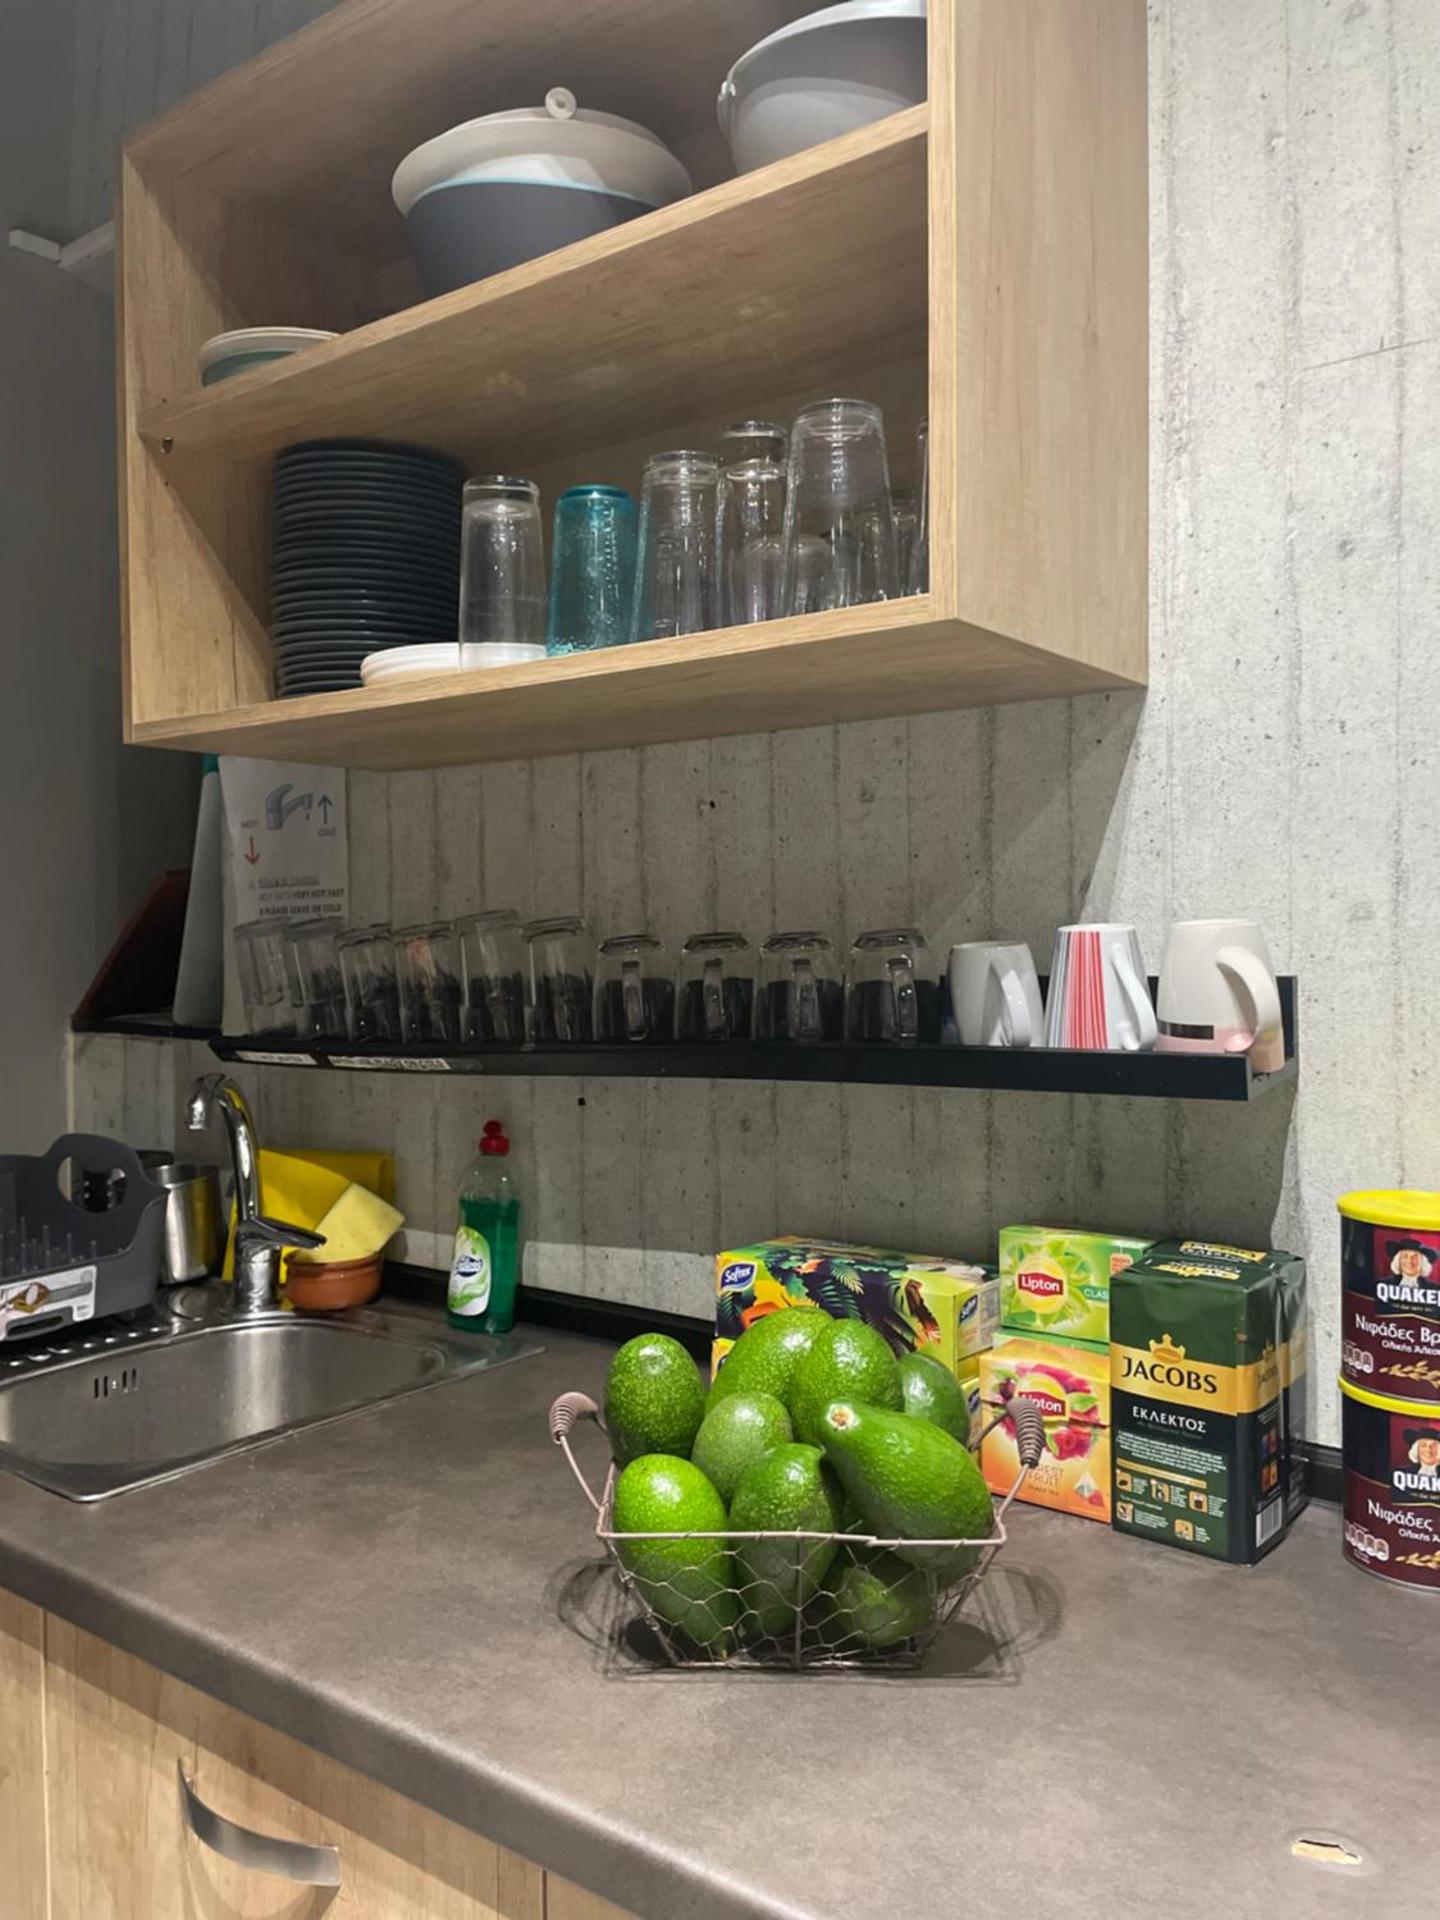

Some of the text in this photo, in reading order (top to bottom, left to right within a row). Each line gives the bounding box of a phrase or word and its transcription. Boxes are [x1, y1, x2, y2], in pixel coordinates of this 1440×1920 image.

[1021, 1275, 1060, 1292] Lipton
[1376, 1282, 1440, 1307] QUAKE
[1354, 1312, 1415, 1343] Νιφάδες
[1121, 1356, 1218, 1395] JACOBS
[1132, 1406, 1207, 1434] ΕΚΛΕΚΤΟΣ
[1367, 1497, 1433, 1532] Νιφάδες
